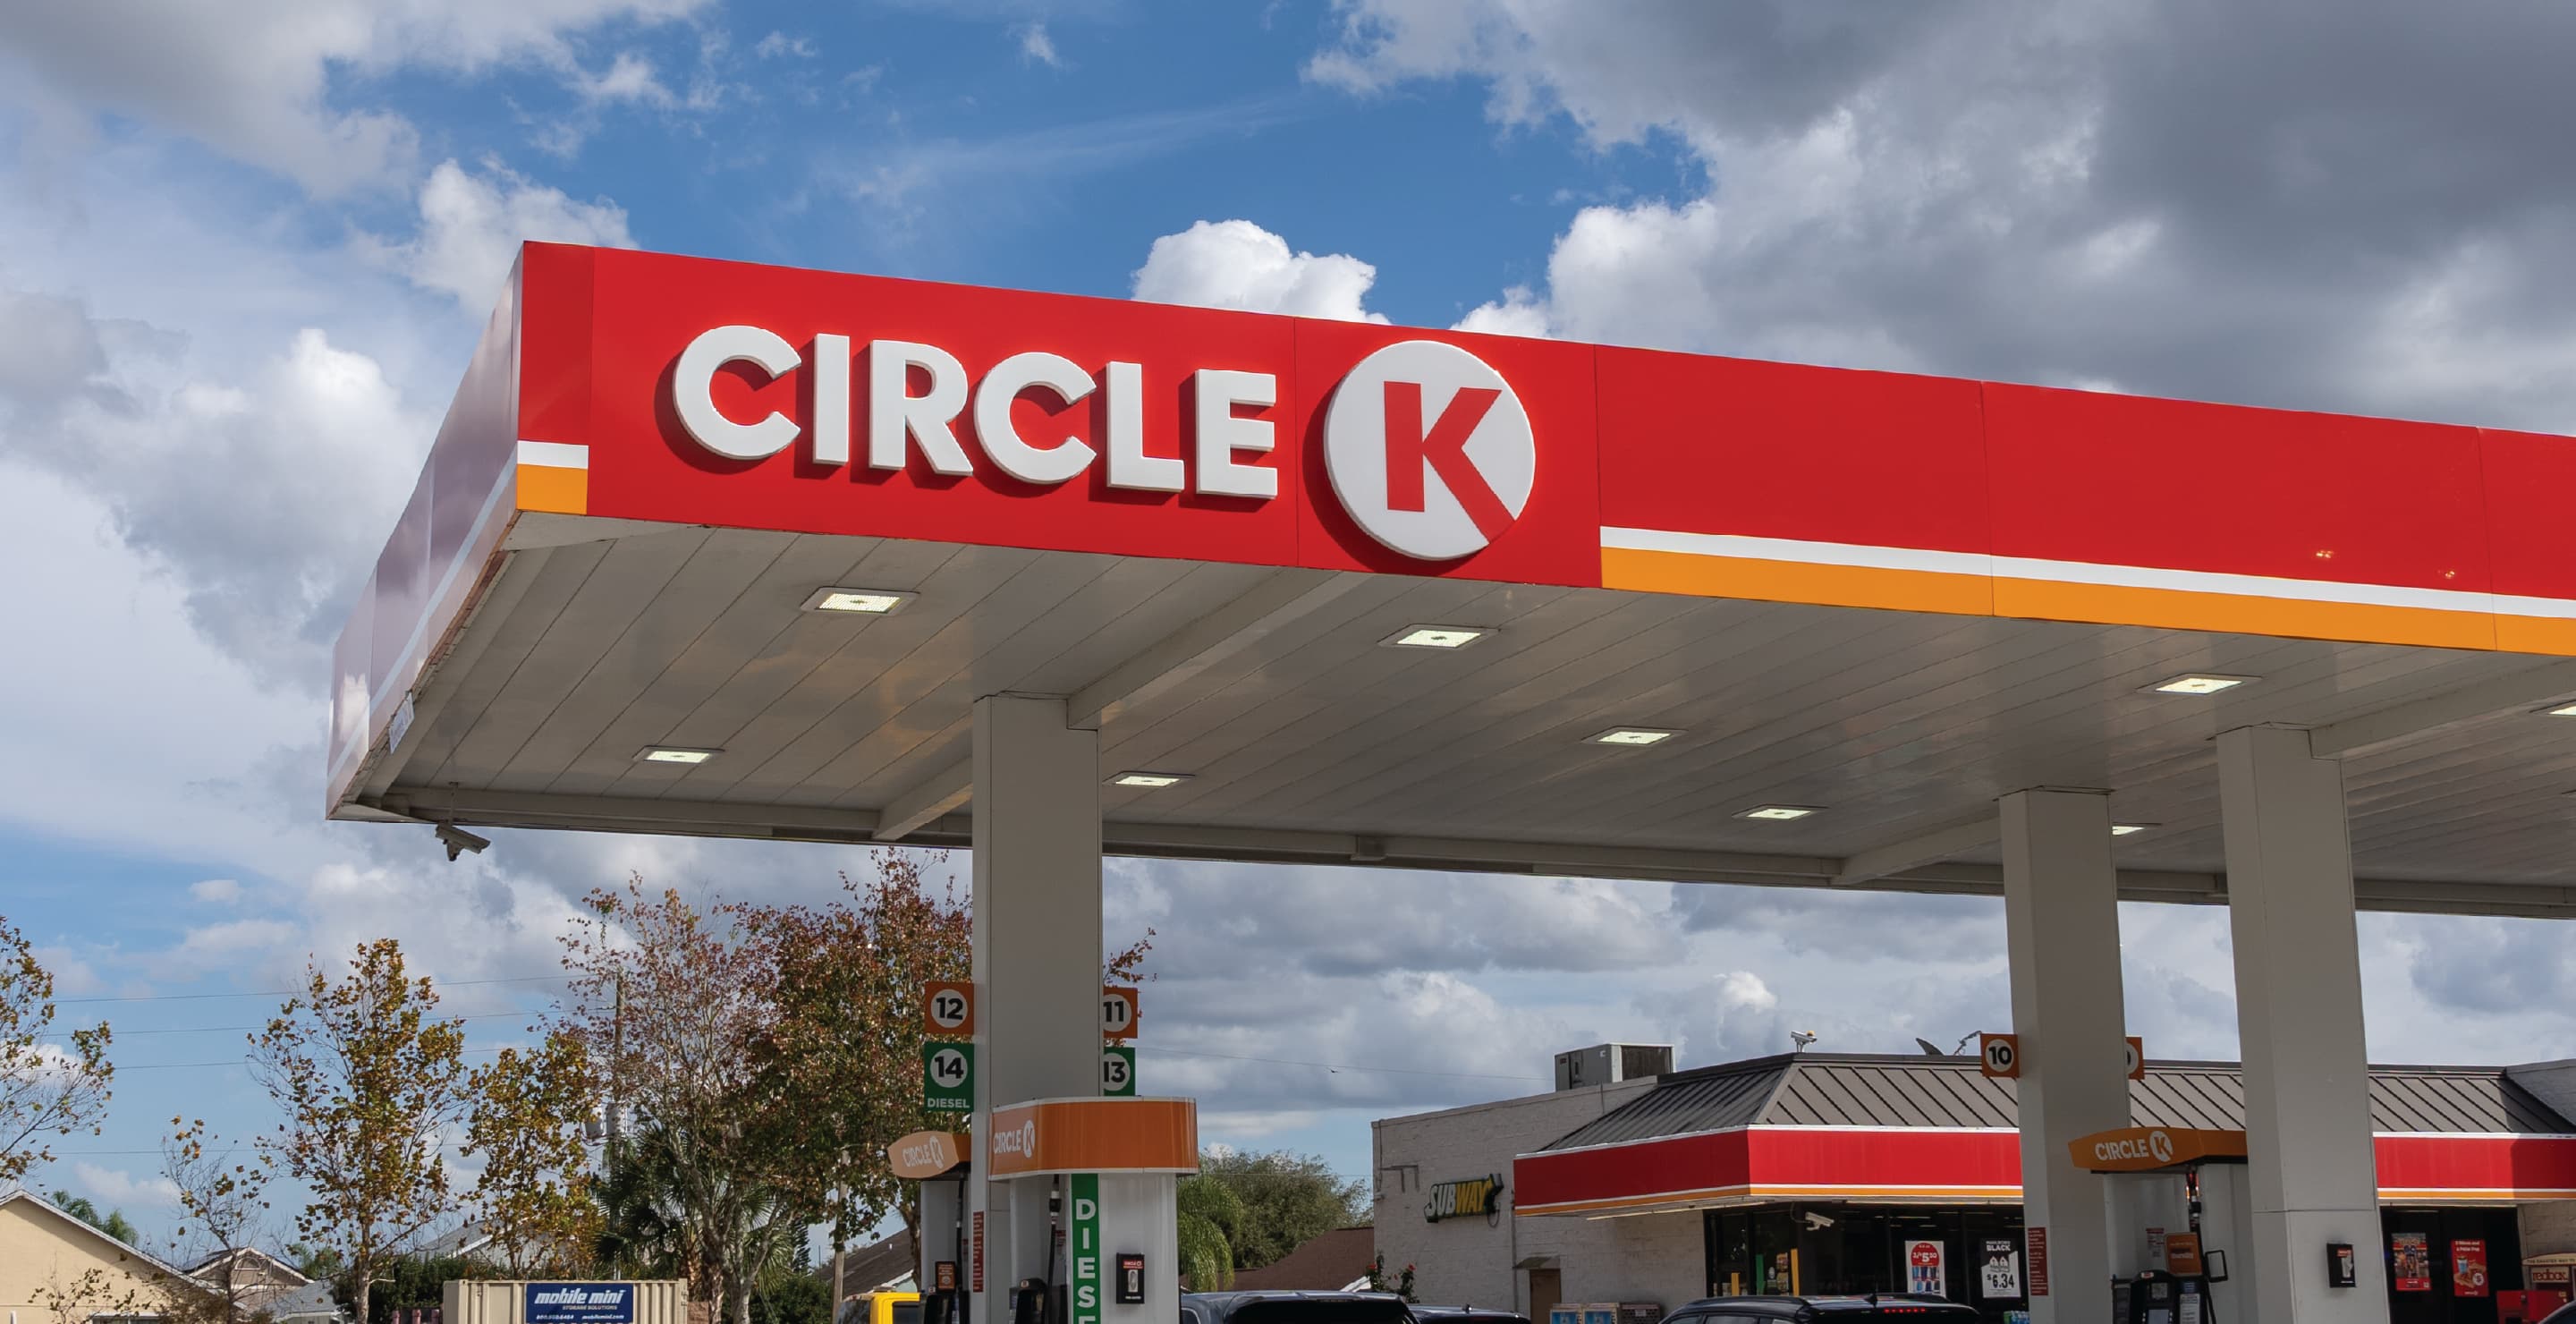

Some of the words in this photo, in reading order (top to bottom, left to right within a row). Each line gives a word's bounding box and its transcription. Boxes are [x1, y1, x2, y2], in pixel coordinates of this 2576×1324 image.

[674, 325, 1277, 498] CIRCLE
[1379, 374, 1519, 547] K
[936, 997, 963, 1020] 12
[1103, 1000, 1124, 1023] 11
[1988, 1046, 2012, 1065] 10
[935, 1056, 964, 1079] 14
[1103, 1061, 1126, 1083] 13
[927, 1098, 970, 1108] DIESEL
[994, 1129, 1021, 1154] CIRCLE
[1024, 1125, 1035, 1155] K
[2095, 1139, 2149, 1160] CIRCLE
[2152, 1133, 2173, 1160] K
[902, 1144, 932, 1167] CIRCLE
[1425, 1177, 1494, 1217] SUBWAY
[1987, 1273, 2014, 1288] $6.34
[534, 1288, 588, 1304] mobile
[588, 1290, 623, 1304] mini
